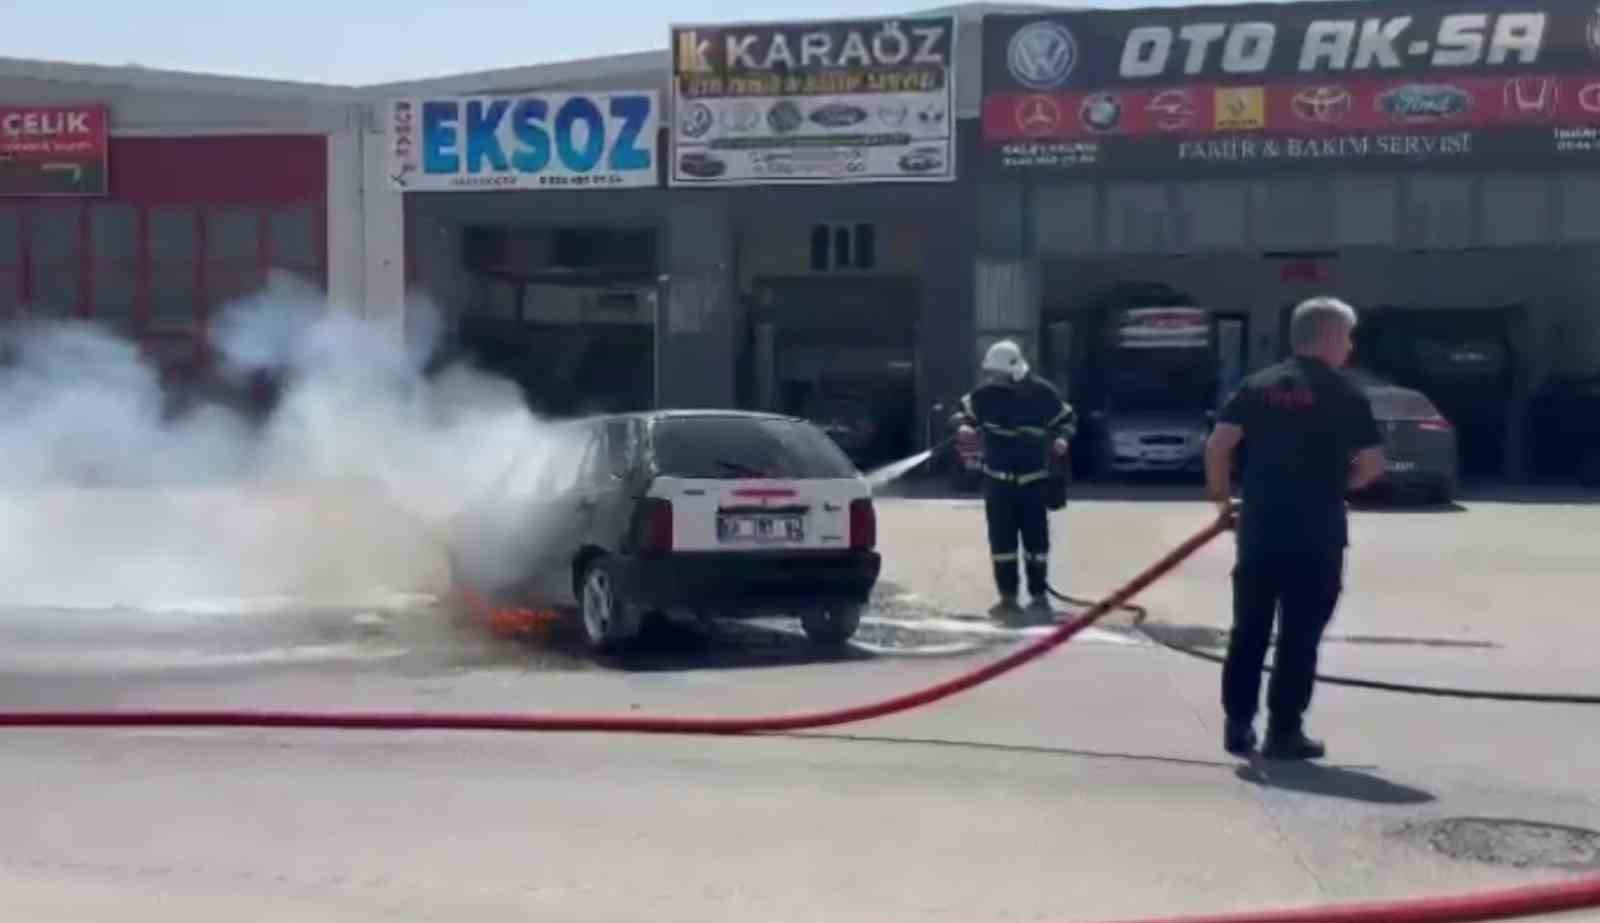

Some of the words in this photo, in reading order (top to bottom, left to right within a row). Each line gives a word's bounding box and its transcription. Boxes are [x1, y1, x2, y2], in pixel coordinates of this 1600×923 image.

[726, 22, 943, 69] KARAÖZ
[1119, 22, 1276, 77] OTO
[1298, 12, 1545, 70] AK-SA
[423, 95, 651, 174] EKSOZ
[1262, 138, 1281, 157] &
